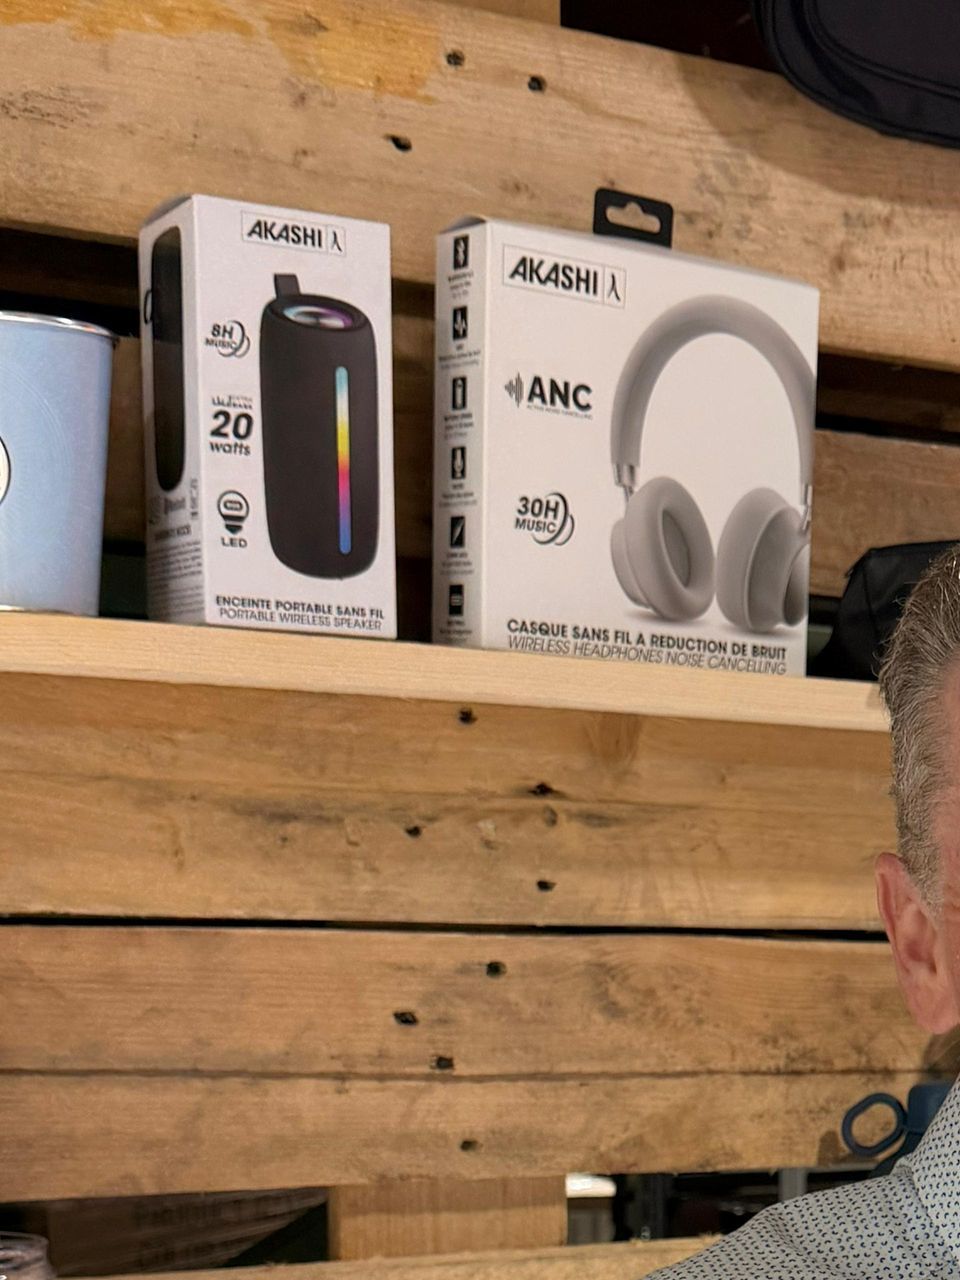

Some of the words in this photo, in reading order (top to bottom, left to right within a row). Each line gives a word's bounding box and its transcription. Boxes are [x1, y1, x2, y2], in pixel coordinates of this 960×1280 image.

[247, 219, 322, 248] AKASHI
[509, 255, 598, 296] AKASHI
[211, 323, 234, 340] 8H
[527, 375, 592, 412] ANC
[210, 410, 254, 440] 20
[209, 441, 251, 457] watts
[517, 496, 559, 520] 30H
[515, 517, 557, 534] MUSIC
[221, 536, 248, 548] LED
[216, 595, 272, 611] ENCEINTE
[275, 600, 333, 616] PORTABLE
[336, 605, 366, 618] SANS
[370, 607, 385, 620] FIL
[219, 606, 276, 623] PORTABLE
[279, 611, 331, 627] WIRELESS
[333, 616, 382, 632] SPEAKER
[507, 618, 568, 638] CASQUE
[572, 625, 610, 641] SANS
[614, 630, 632, 645] FIL
[650, 633, 727, 655] REDUCTION
[731, 641, 748, 657] DE
[752, 644, 787, 660] BRUIT
[508, 634, 570, 655] WIRELESS
[573, 641, 664, 664] HEADPHONES
[666, 651, 704, 669] NOISE
[707, 654, 787, 675] CANCELLING
